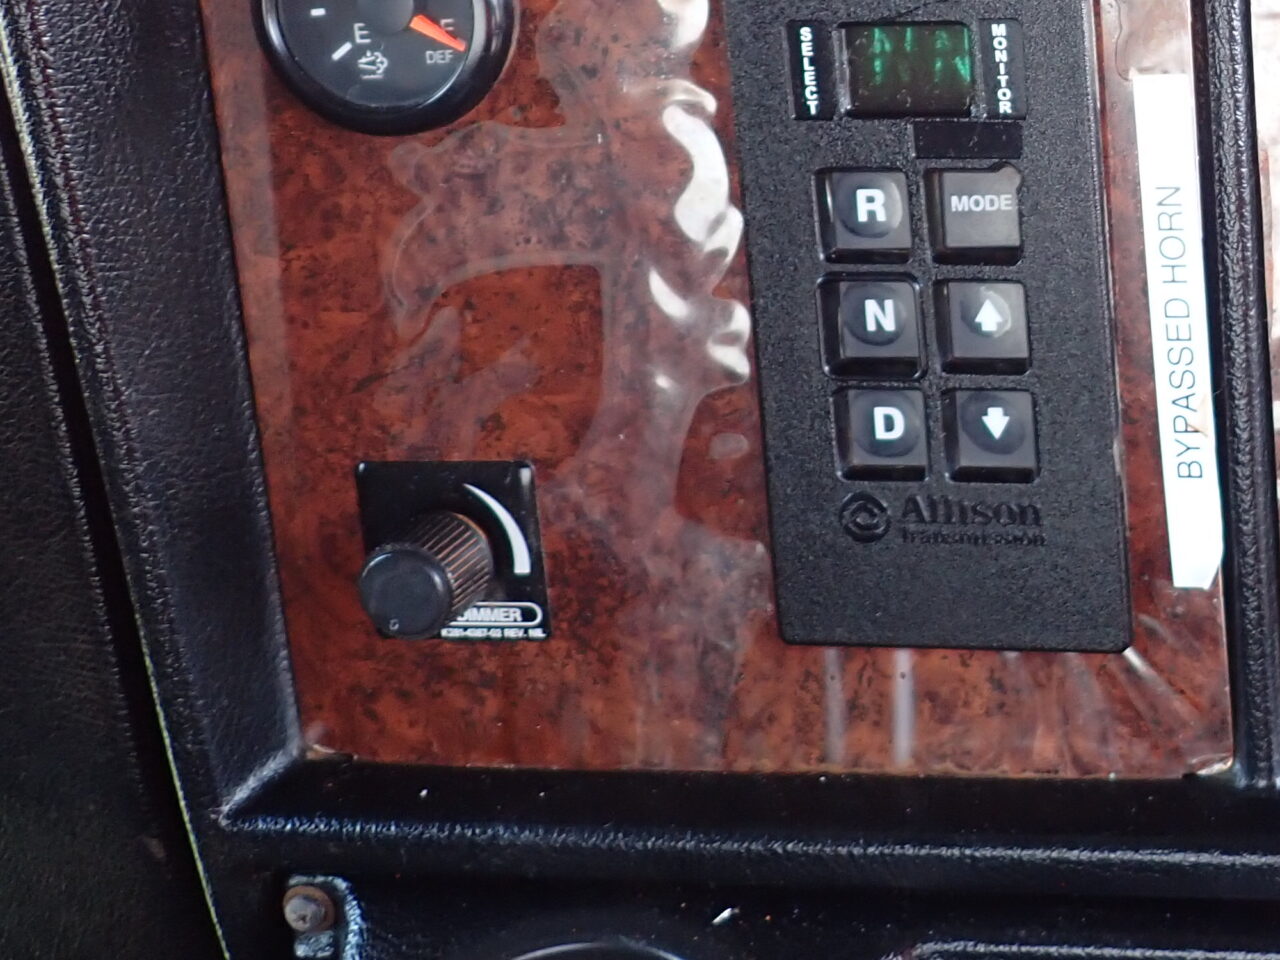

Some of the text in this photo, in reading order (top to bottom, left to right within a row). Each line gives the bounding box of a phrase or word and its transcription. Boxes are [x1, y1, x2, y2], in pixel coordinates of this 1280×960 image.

[353, 23, 371, 44] E
[424, 50, 453, 65] DEF
[799, 26, 819, 116] SELECT
[991, 23, 1012, 115] MONITOR
[856, 189, 887, 223] R
[951, 195, 1013, 212] MODE
[864, 299, 897, 332] N
[1155, 185, 1204, 479] BYPASSED HORN
[873, 406, 905, 440] D
[901, 495, 1043, 527] Allison
[457, 607, 523, 622] IMMER
